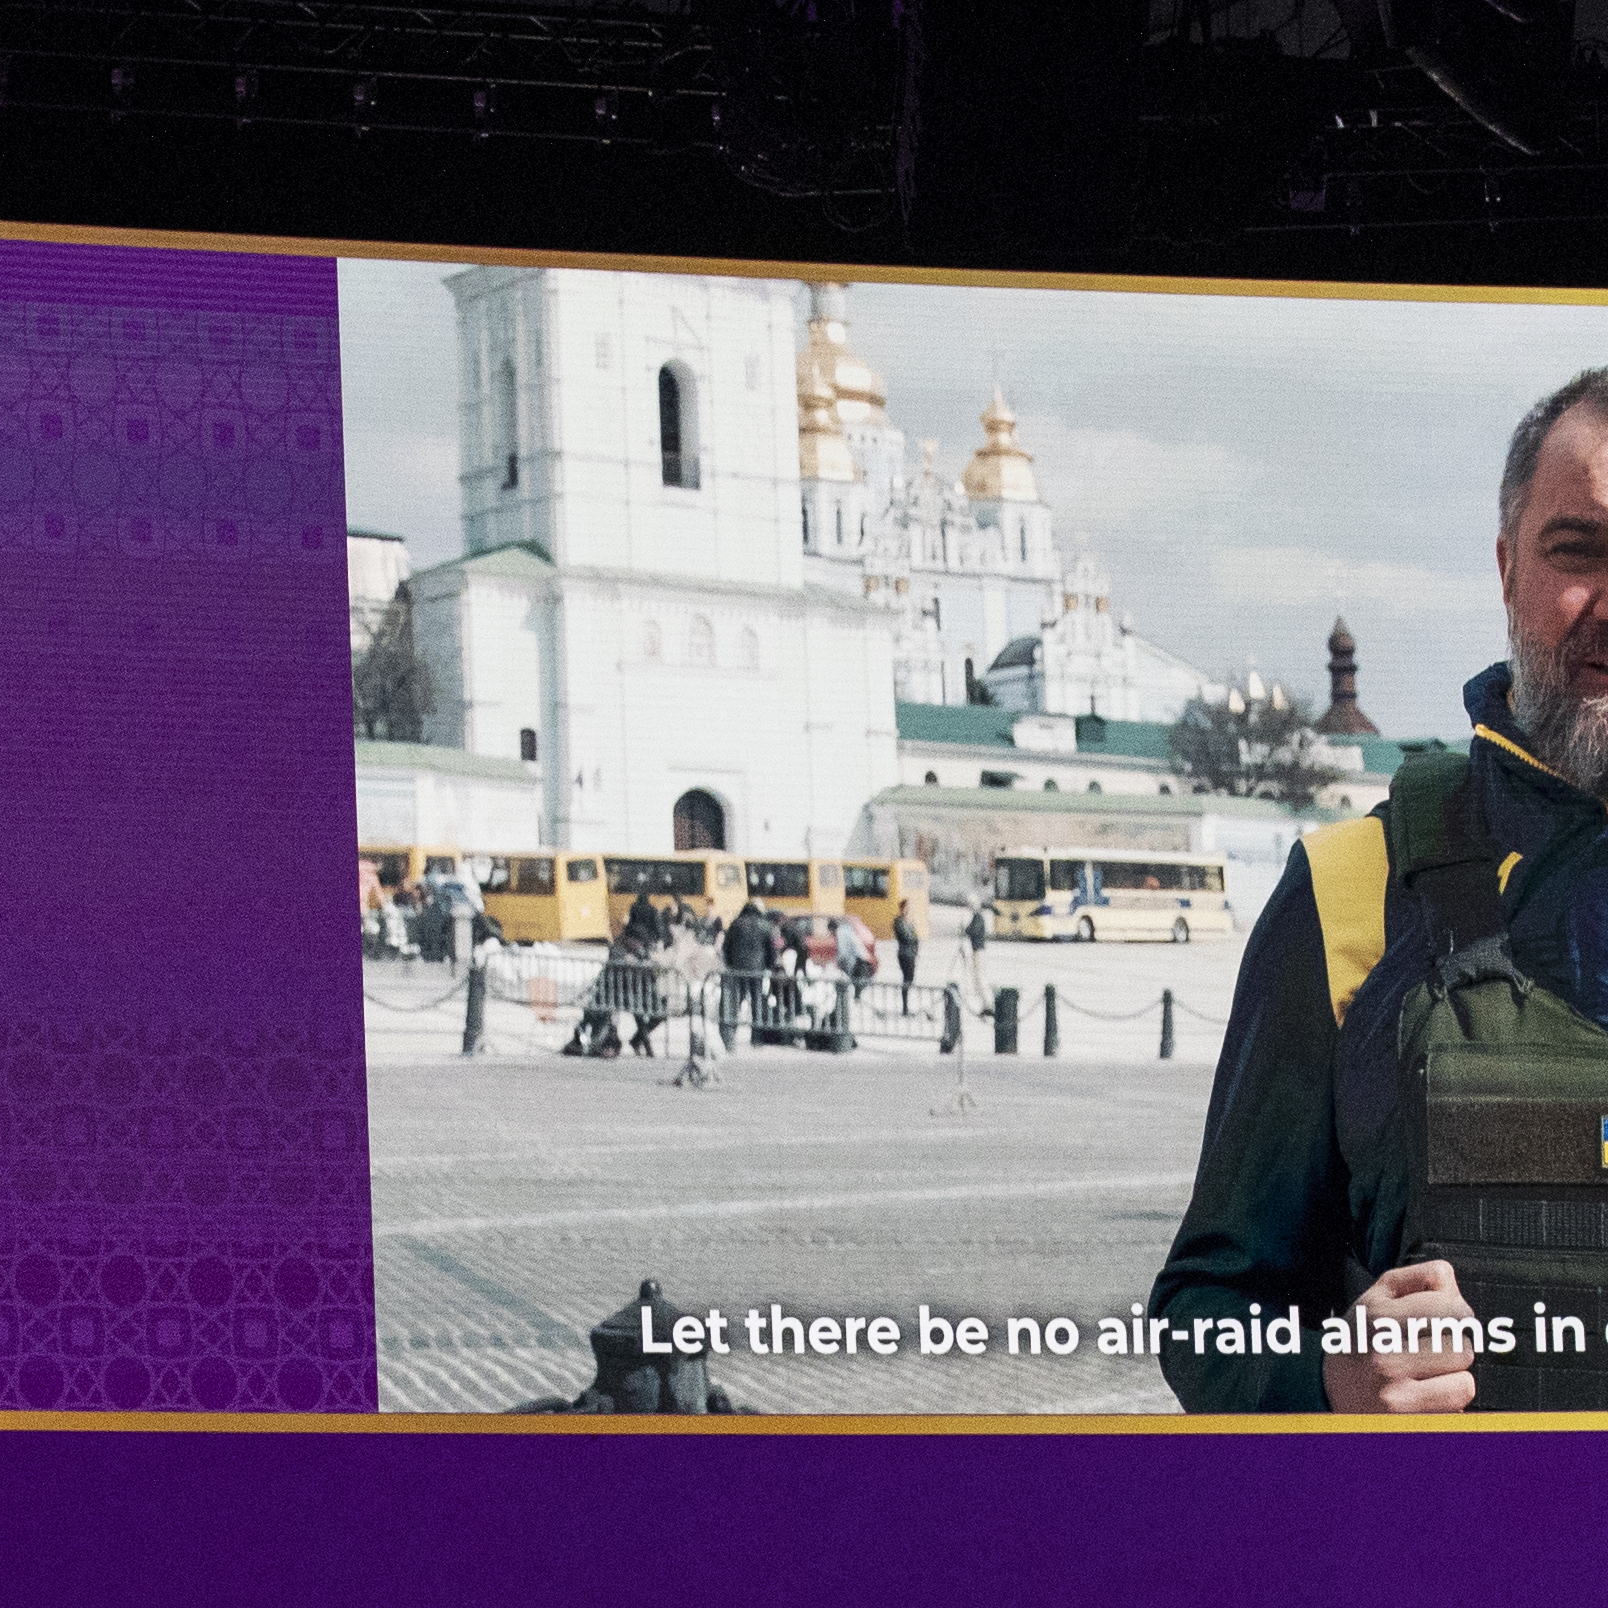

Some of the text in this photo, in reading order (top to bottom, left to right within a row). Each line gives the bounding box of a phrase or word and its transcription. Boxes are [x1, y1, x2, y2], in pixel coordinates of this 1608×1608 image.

[640, 1305, 730, 1355] Let
[743, 1303, 902, 1355] there
[918, 1304, 990, 1355] be
[1006, 1316, 1081, 1355] no
[1096, 1303, 1302, 1355] air-raid
[1320, 1304, 1517, 1354] alarms
[1534, 1302, 1586, 1353] in
